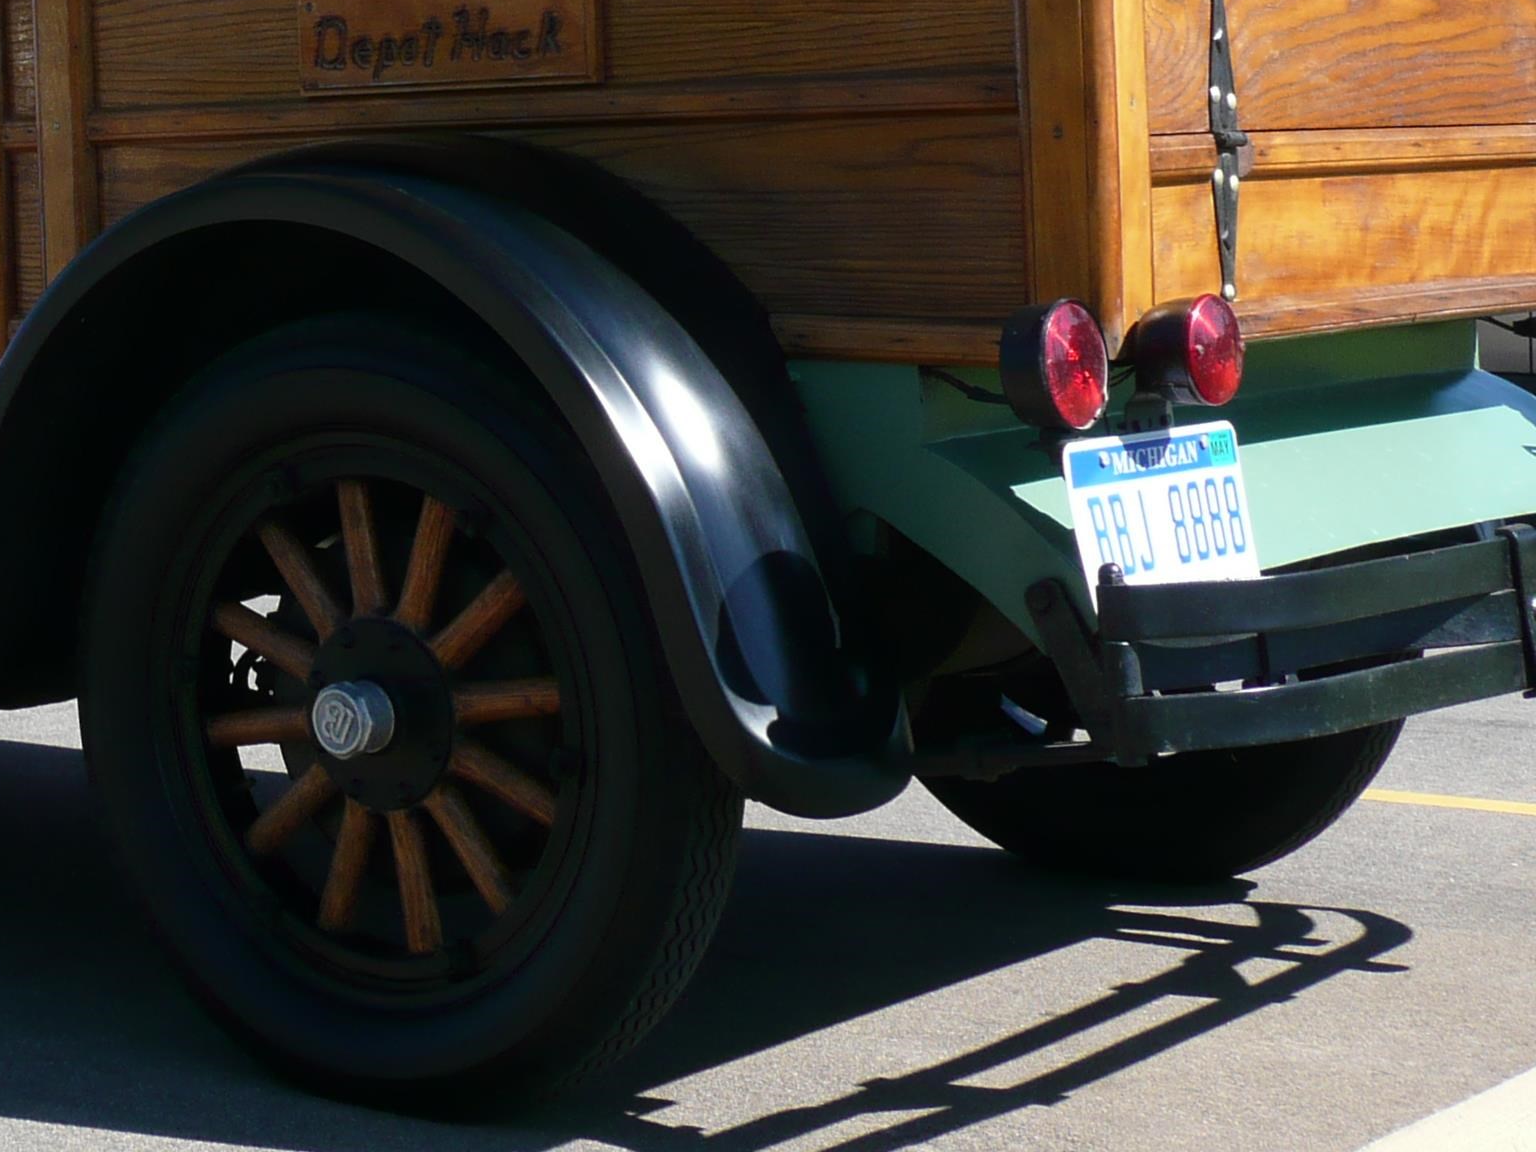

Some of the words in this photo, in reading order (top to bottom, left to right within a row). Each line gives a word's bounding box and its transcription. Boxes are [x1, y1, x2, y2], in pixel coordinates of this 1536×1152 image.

[314, 14, 444, 80] Depot
[450, 4, 564, 62] Hack
[1111, 440, 1199, 476] MICHIGAN
[1209, 440, 1230, 457] MAY
[1168, 476, 1246, 564] 8888
